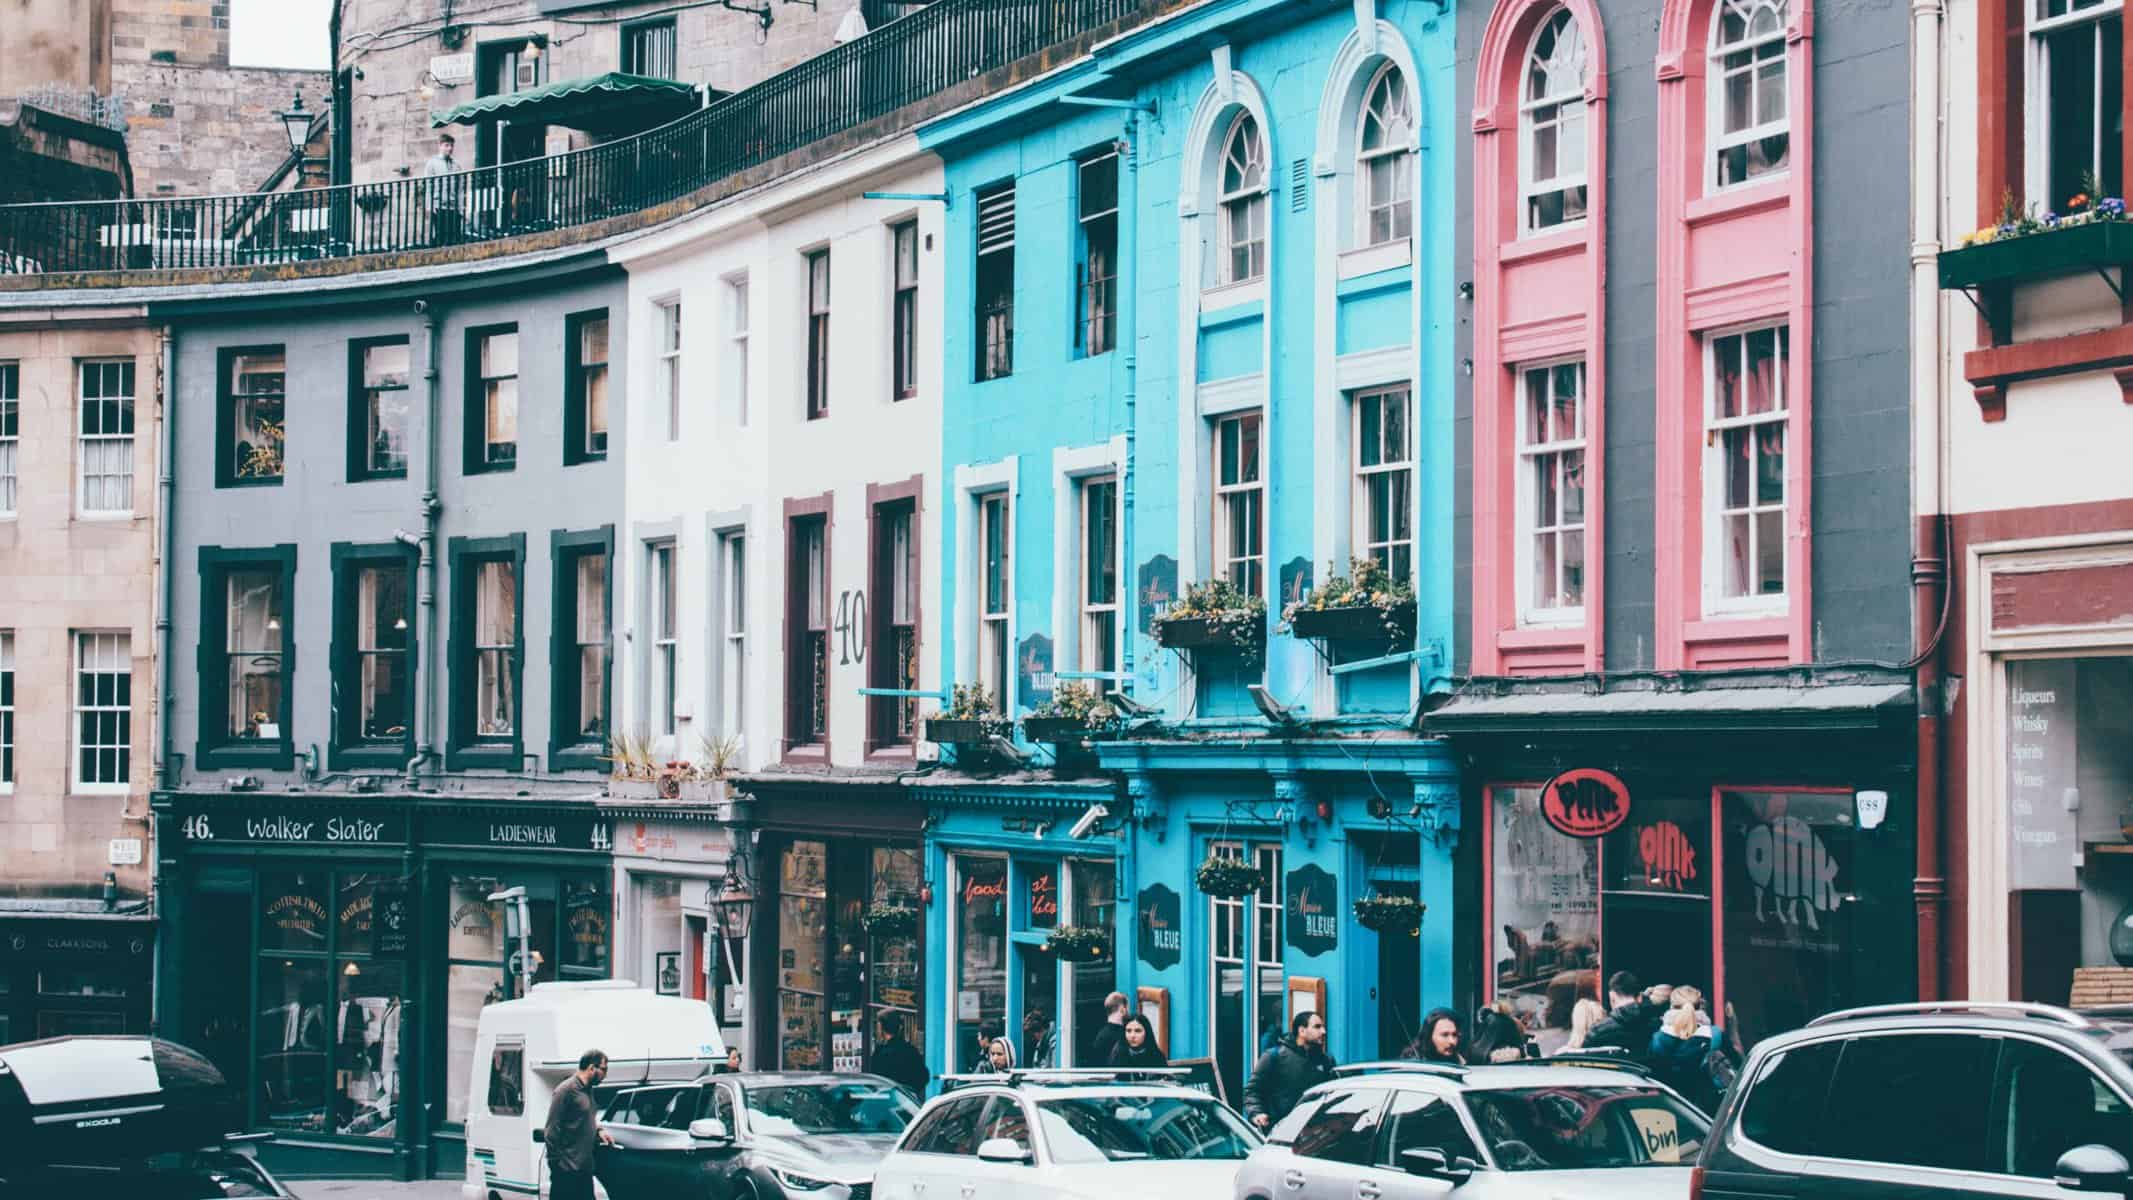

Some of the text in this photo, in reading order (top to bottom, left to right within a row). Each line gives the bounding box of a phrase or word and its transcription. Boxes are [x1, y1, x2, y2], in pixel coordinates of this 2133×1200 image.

[834, 590, 865, 665] 40
[2012, 687, 2056, 708] Liqueurs
[2013, 715, 2049, 735] Whisky
[181, 814, 384, 841] 46. Walker Slater
[489, 824, 557, 844] LADIESWEAR
[591, 823, 611, 849] 44.
[1305, 914, 1337, 938] BLEUE
[1154, 928, 1180, 951] BLEUE
[1645, 1121, 1677, 1154] bin
